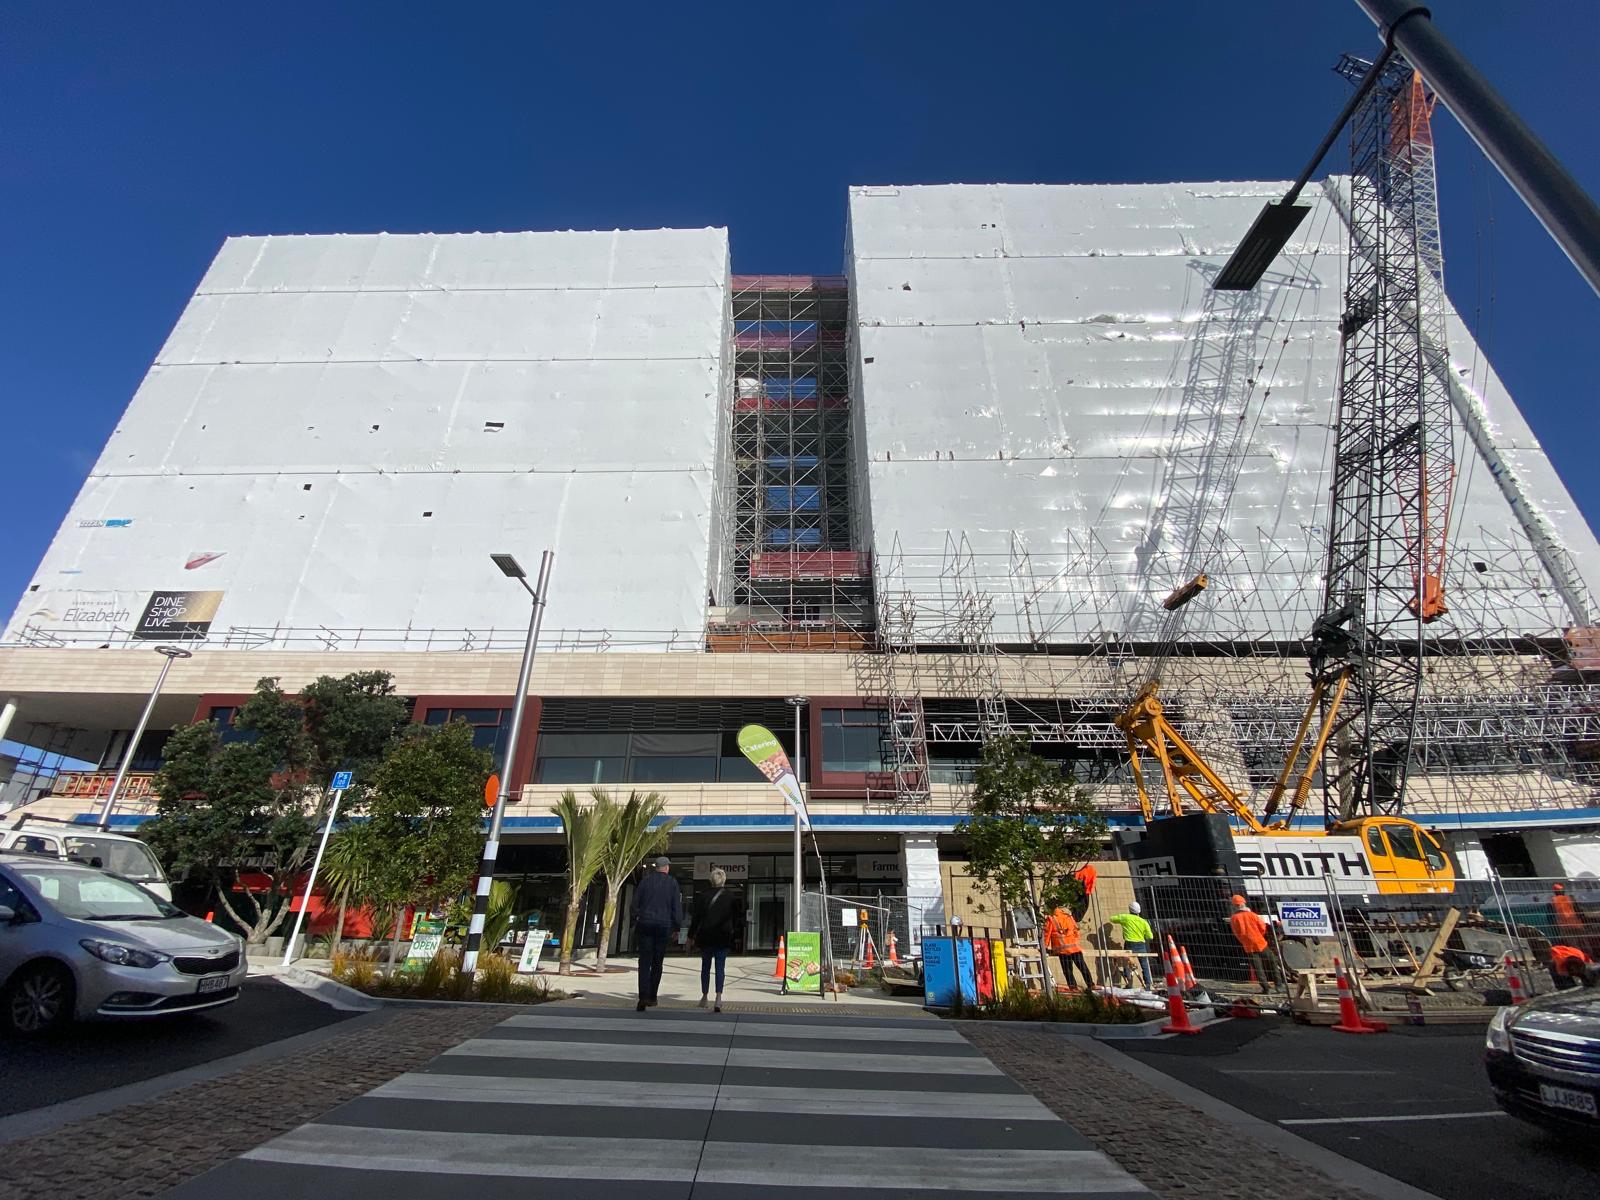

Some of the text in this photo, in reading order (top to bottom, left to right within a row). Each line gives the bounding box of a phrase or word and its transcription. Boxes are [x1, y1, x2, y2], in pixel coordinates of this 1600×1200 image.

[154, 597, 185, 606] DINE
[63, 607, 130, 622] Elizabeth
[149, 607, 187, 617] SHOP
[144, 618, 173, 627] LIVE
[744, 738, 777, 752] Catering
[709, 862, 747, 872] Farmers
[413, 941, 437, 950] OPEN
